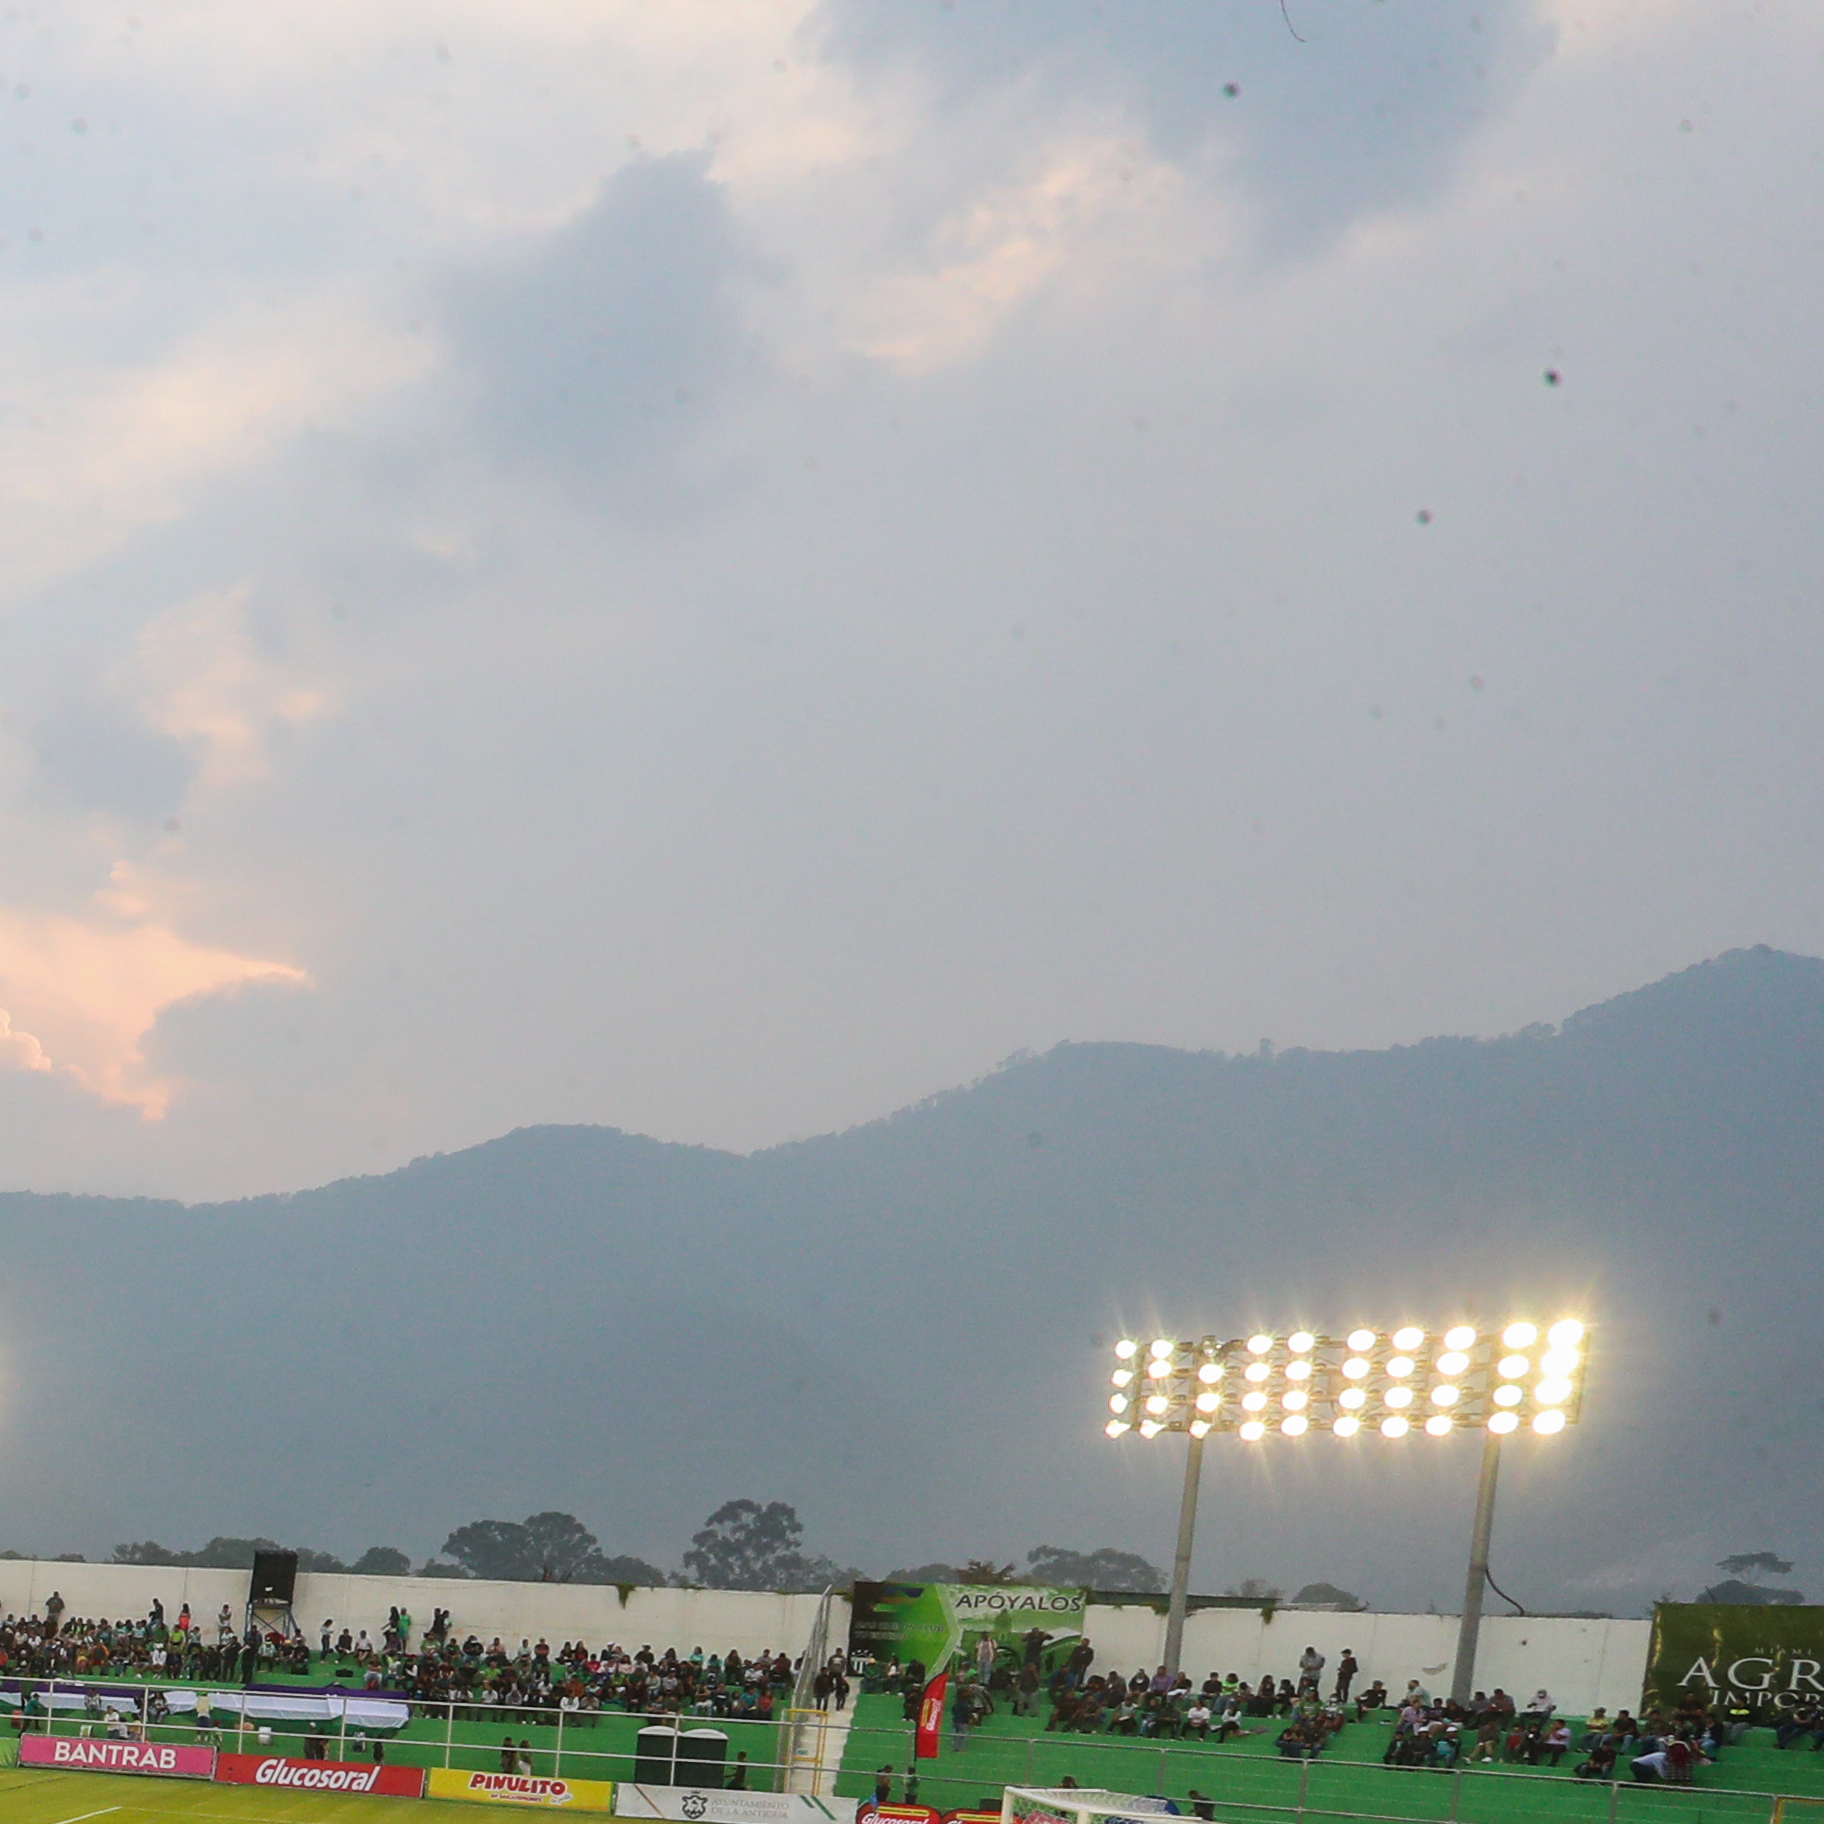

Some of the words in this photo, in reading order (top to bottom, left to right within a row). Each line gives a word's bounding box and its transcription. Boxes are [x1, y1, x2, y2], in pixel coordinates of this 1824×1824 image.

[956, 1591, 1083, 1612] APÓYALOS
[54, 1742, 177, 1770] BANTRAB
[255, 1758, 380, 1792] Glucosoral
[469, 1773, 567, 1796] PINULITO
[711, 1798, 790, 1810] AYUNTAMIENTO
